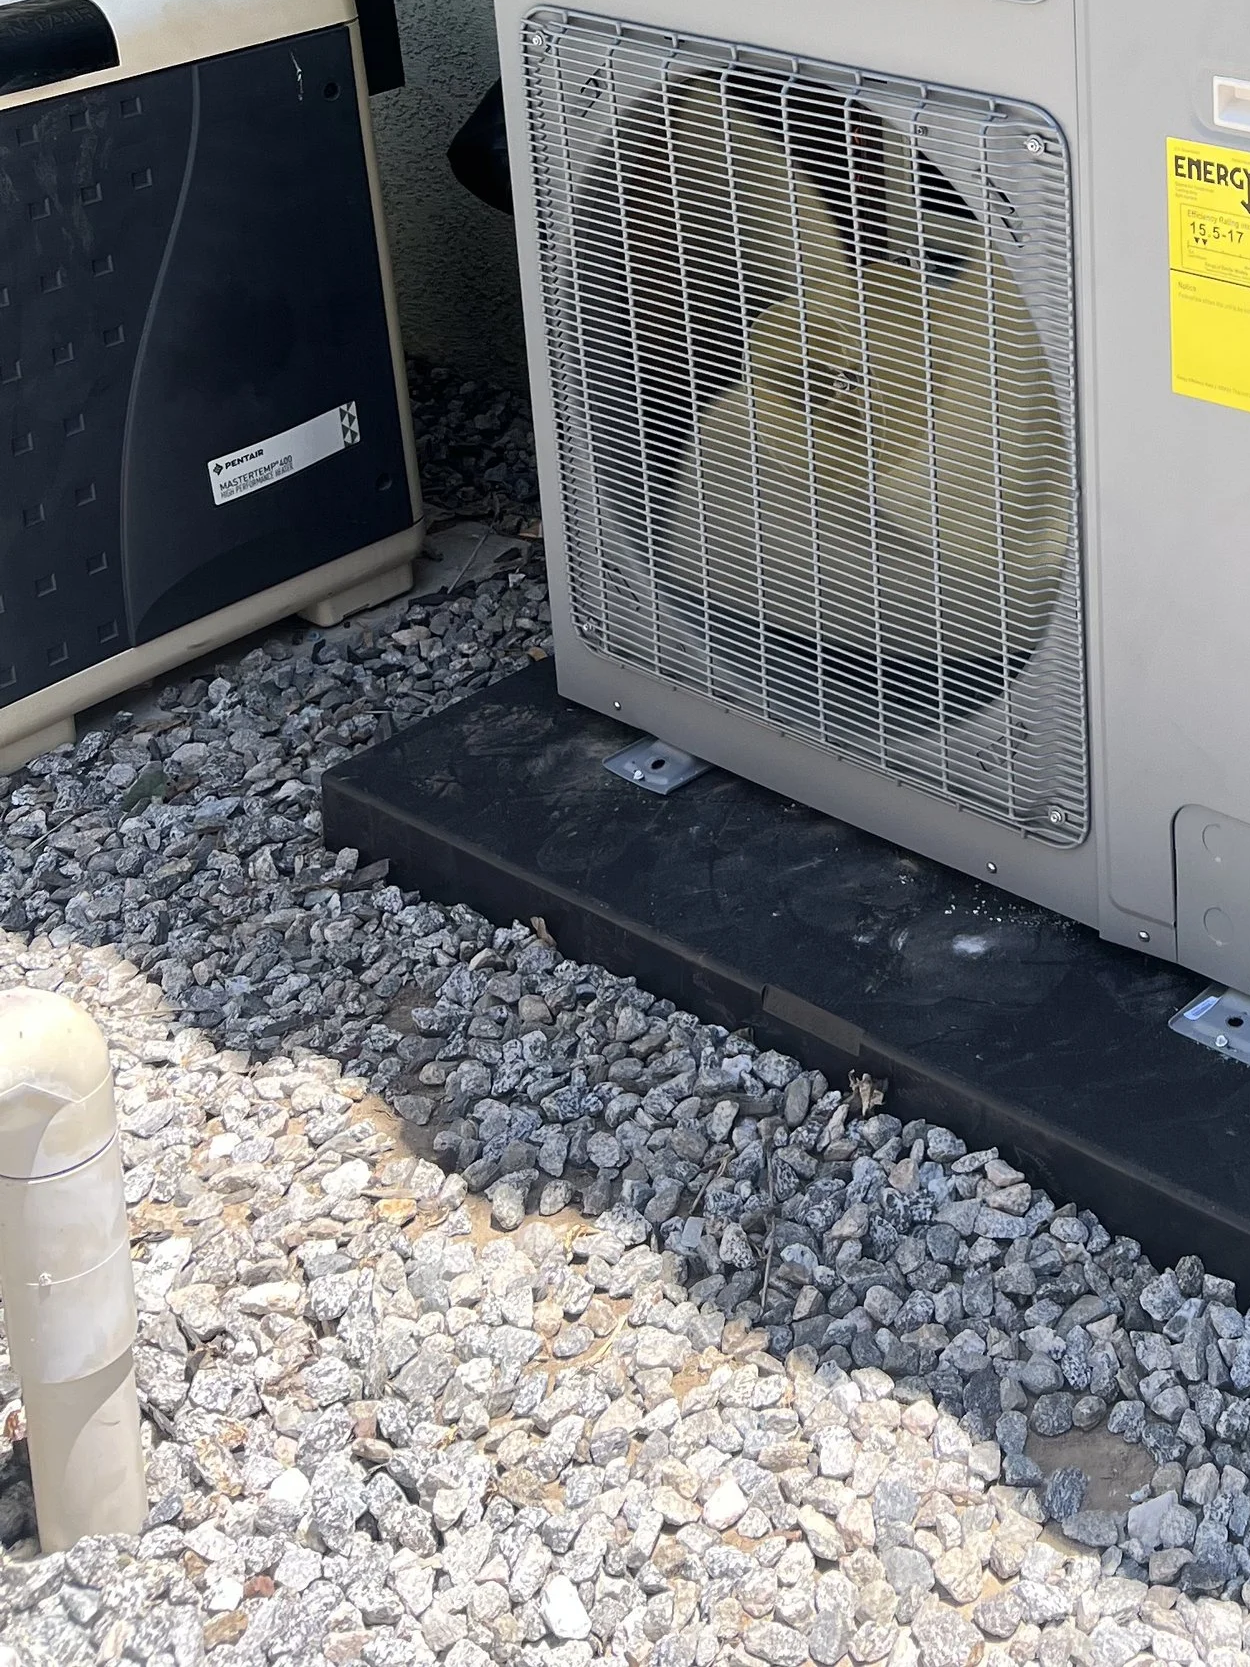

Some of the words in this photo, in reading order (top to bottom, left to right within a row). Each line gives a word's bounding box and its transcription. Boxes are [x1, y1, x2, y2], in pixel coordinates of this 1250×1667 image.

[1190, 221, 1245, 244] 15.5-17
[224, 449, 264, 470] PENTAIR
[235, 472, 274, 494] PERFORMANCE
